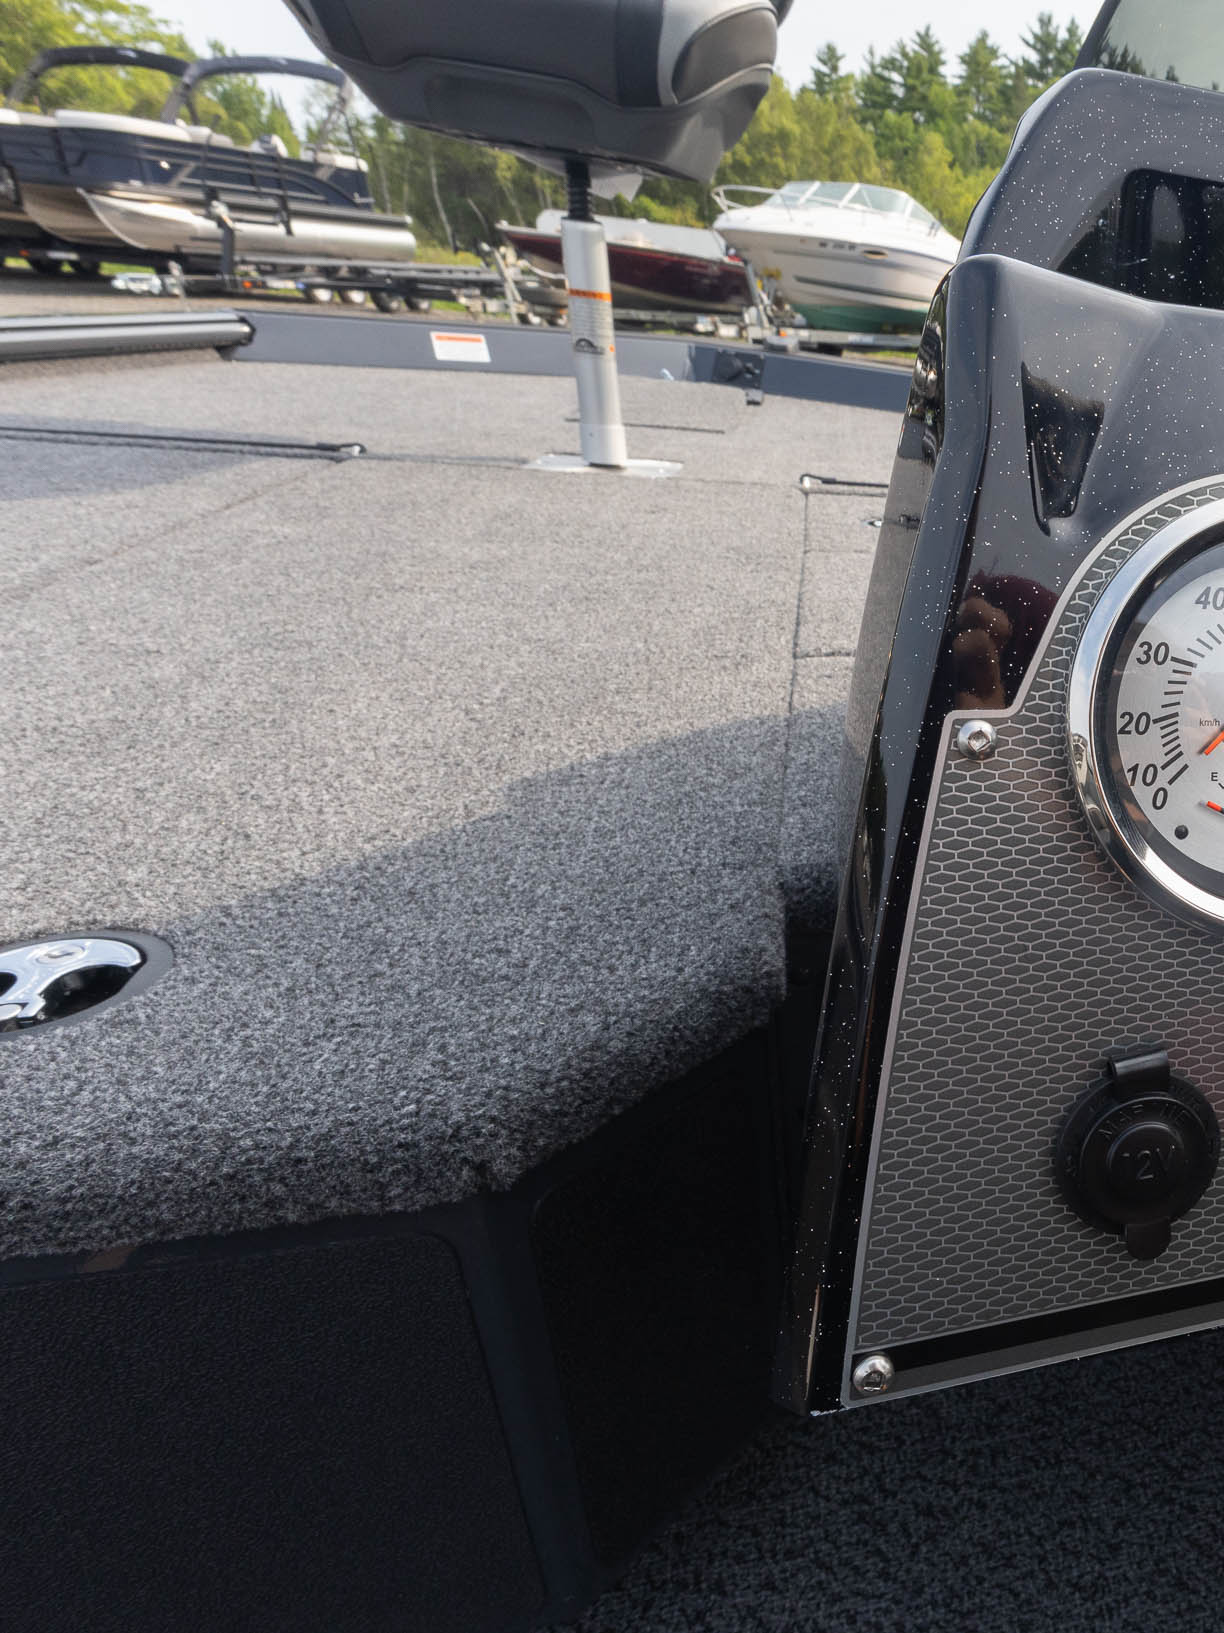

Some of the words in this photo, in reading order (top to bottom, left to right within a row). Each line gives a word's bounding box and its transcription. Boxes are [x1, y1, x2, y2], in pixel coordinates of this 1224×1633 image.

[1135, 641, 1170, 666] 30
[1117, 711, 1151, 736] 20
[1199, 718, 1221, 727] km/h
[1126, 763, 1159, 787] 10
[1211, 771, 1219, 782] E
[1151, 786, 1169, 811] 0
